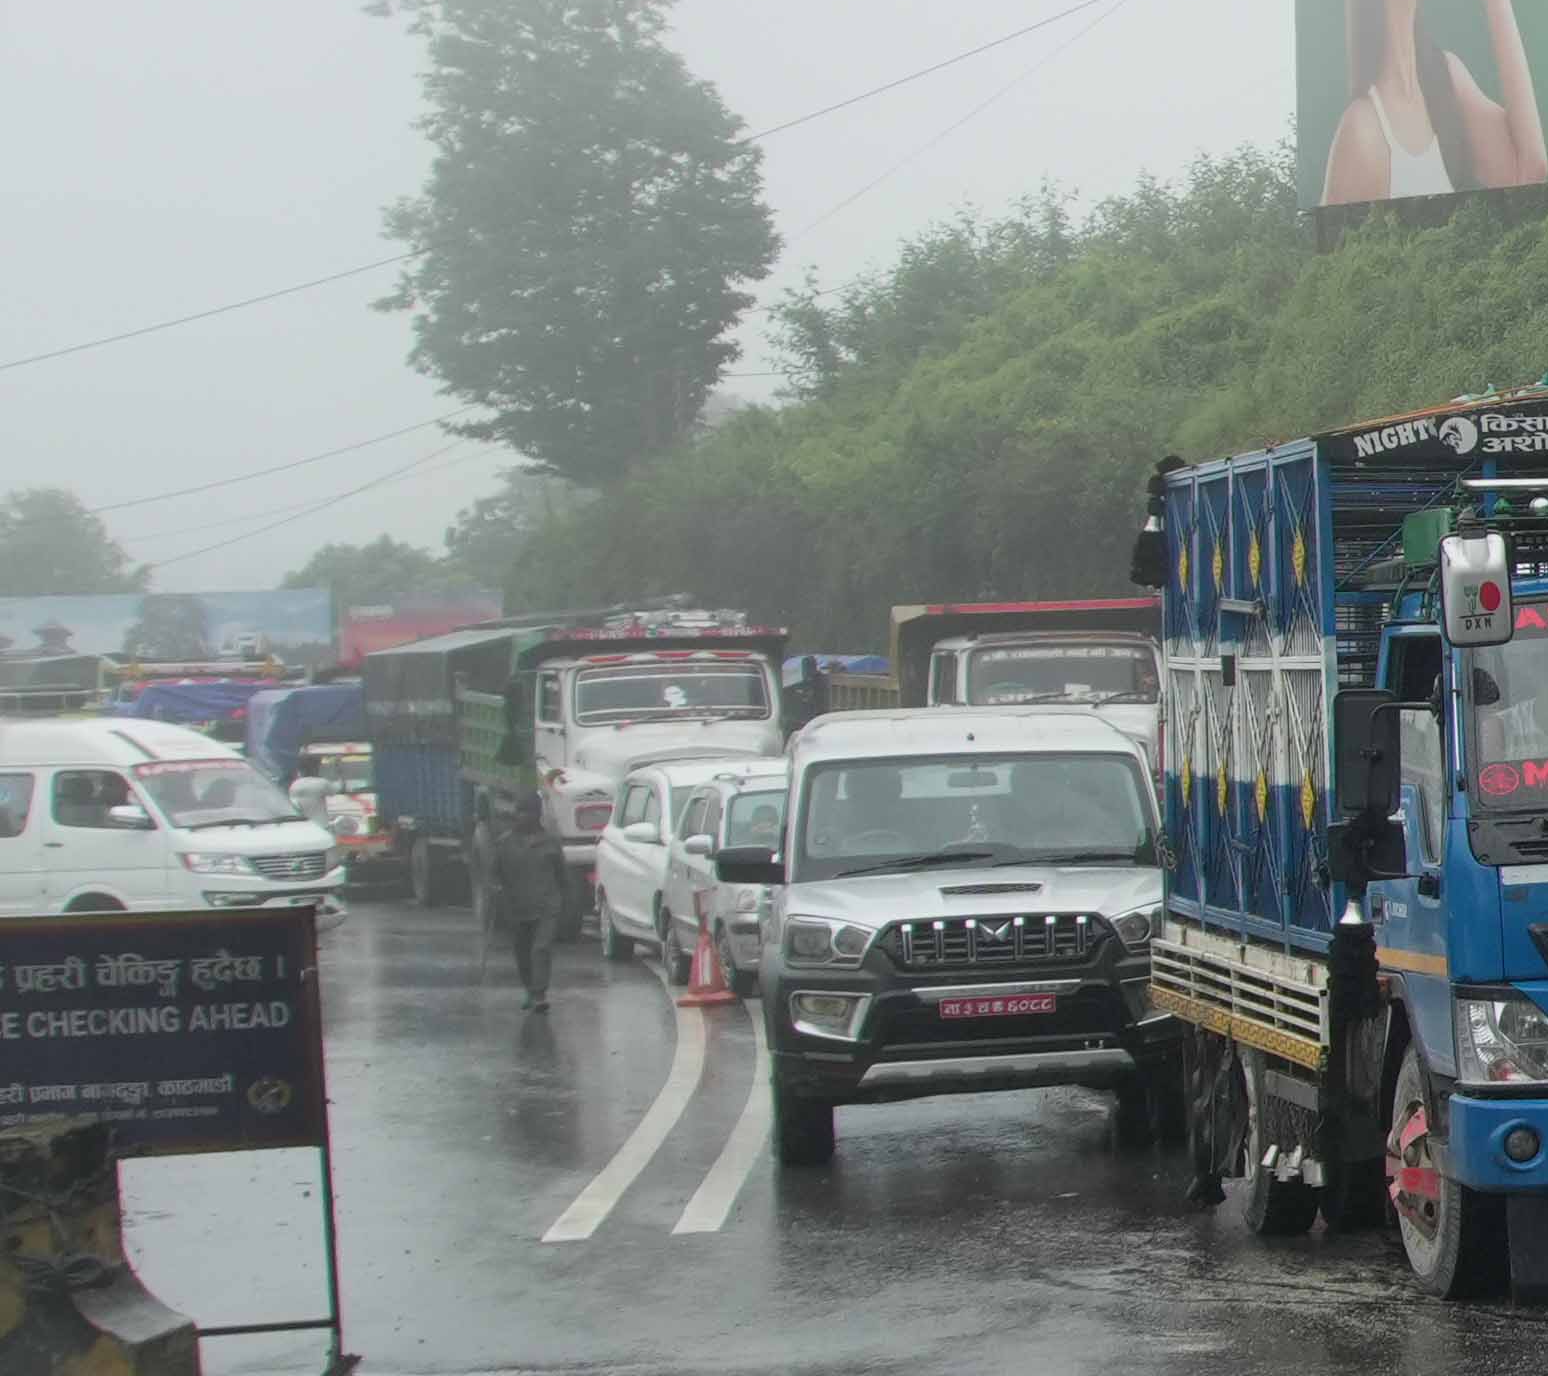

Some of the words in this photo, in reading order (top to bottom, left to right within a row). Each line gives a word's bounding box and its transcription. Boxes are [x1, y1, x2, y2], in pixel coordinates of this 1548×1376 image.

[1353, 419, 1429, 457] NIGHT
[15, 955, 87, 994] प्रहरी
[26, 1007, 181, 1038] CHECKING
[188, 1001, 290, 1033] AHEAD
